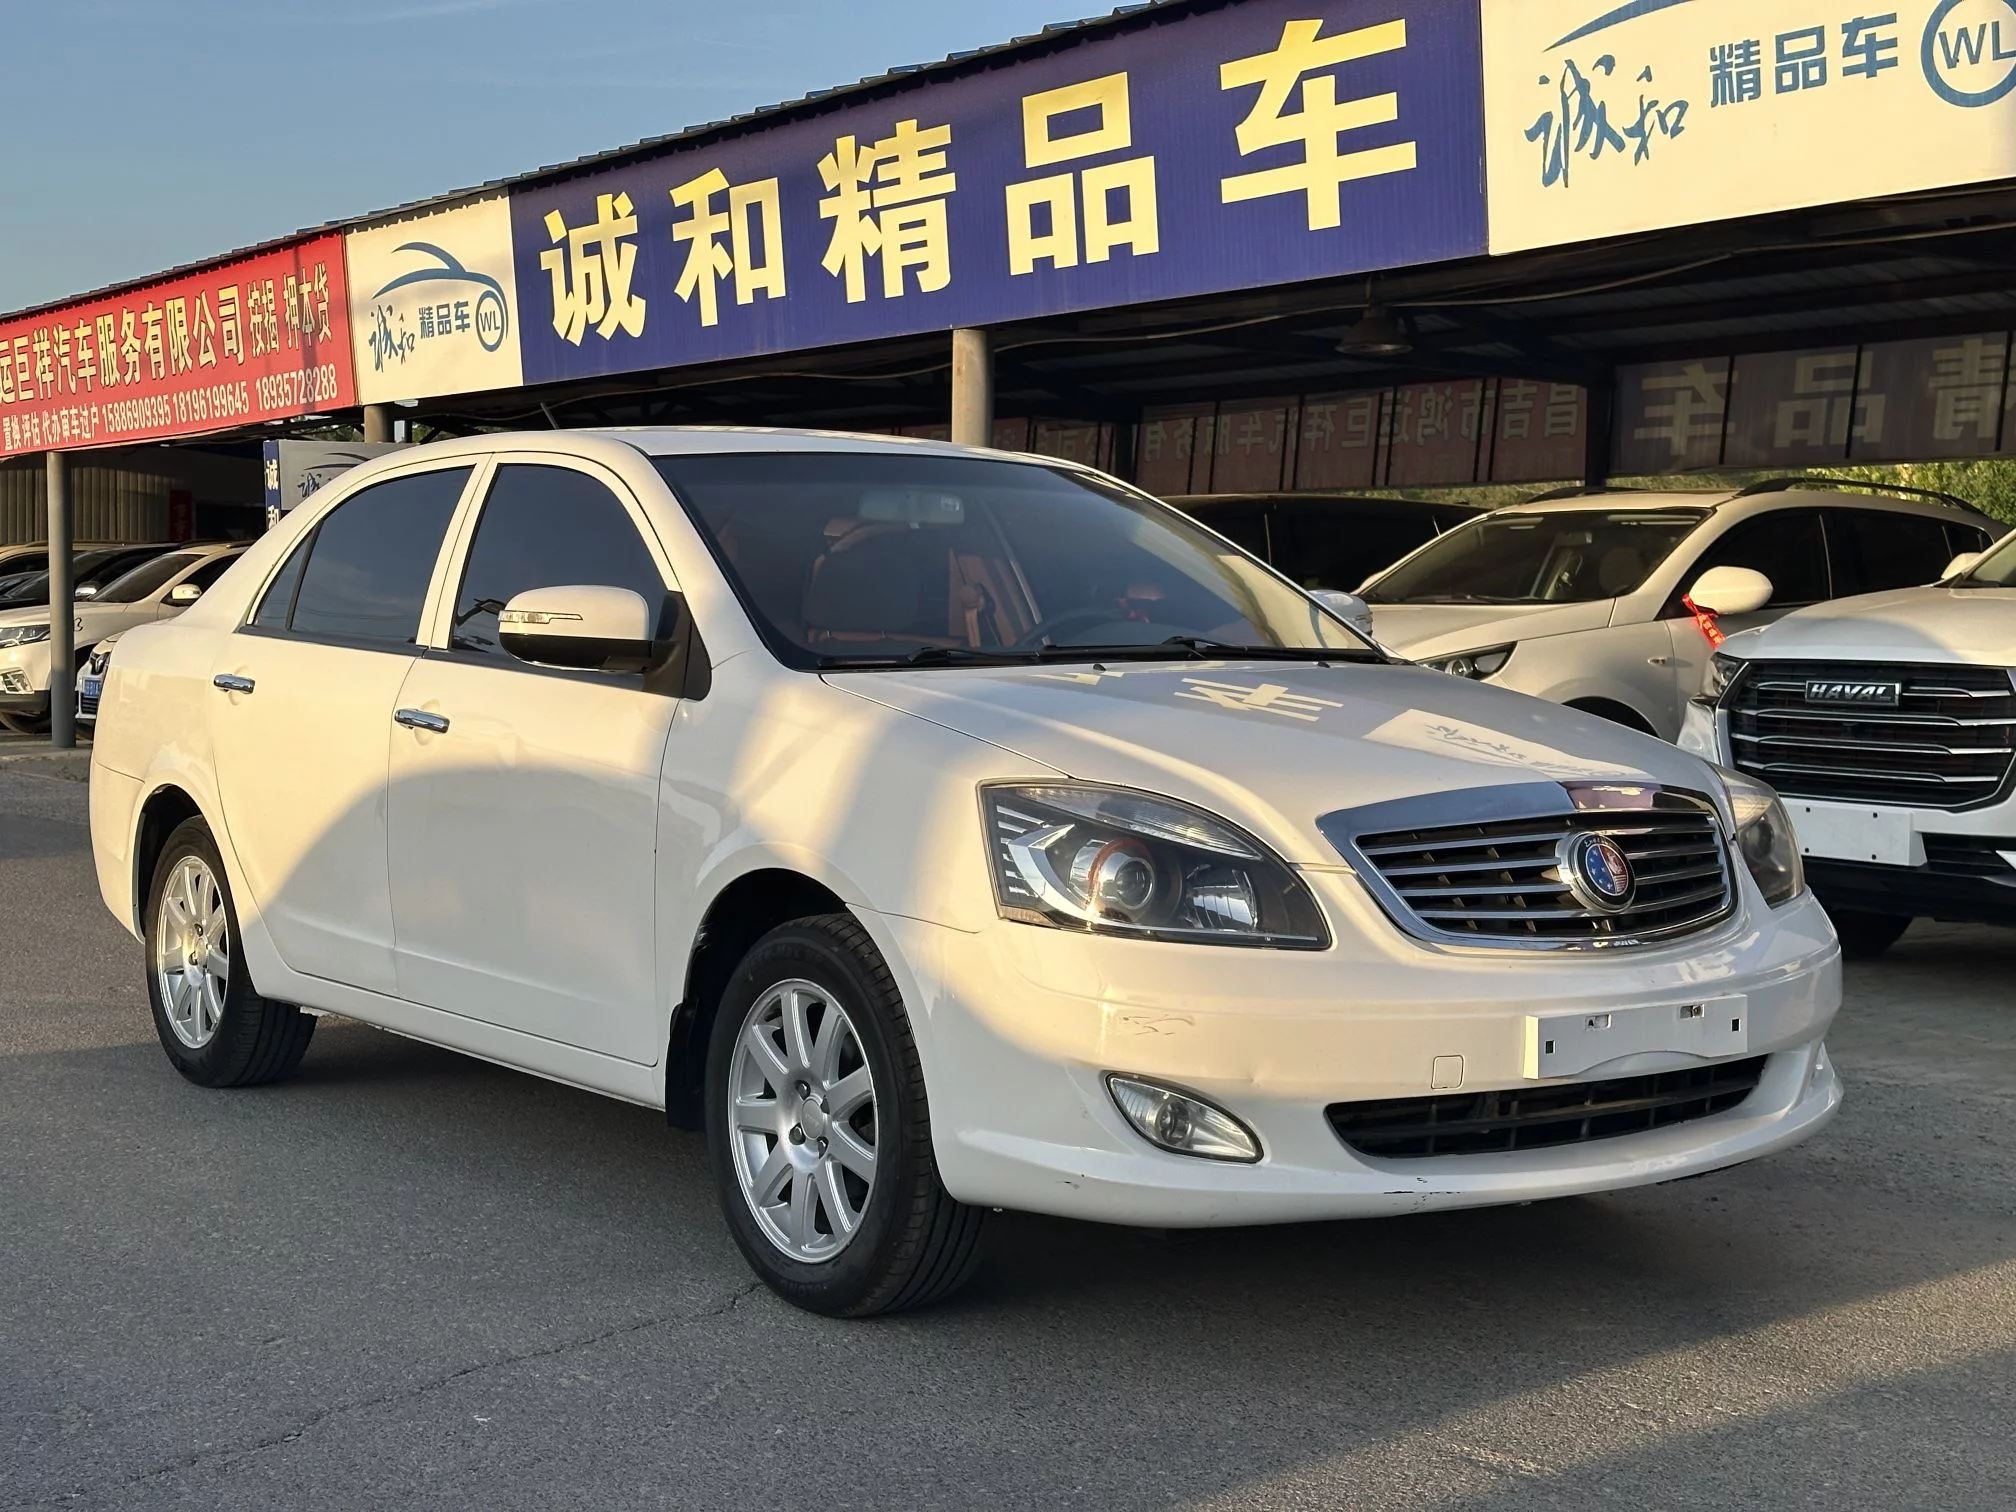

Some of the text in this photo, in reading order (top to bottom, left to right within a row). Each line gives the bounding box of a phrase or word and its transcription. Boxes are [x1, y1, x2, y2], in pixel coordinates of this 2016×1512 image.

[1709, 12, 1899, 108] 精品车
[1939, 20, 2016, 67] WL
[539, 19, 1417, 348] 诚和精品车
[0, 284, 244, 403] 运巨祥汽车服务有限公司
[418, 300, 471, 339] 精品车
[479, 311, 501, 332] WL
[42, 402, 99, 444] 代办审车过户
[102, 394, 171, 433] 15886909395
[172, 381, 249, 424] 18196199645
[255, 363, 338, 412] 18935728288
[1809, 683, 1892, 702] HAVAL
